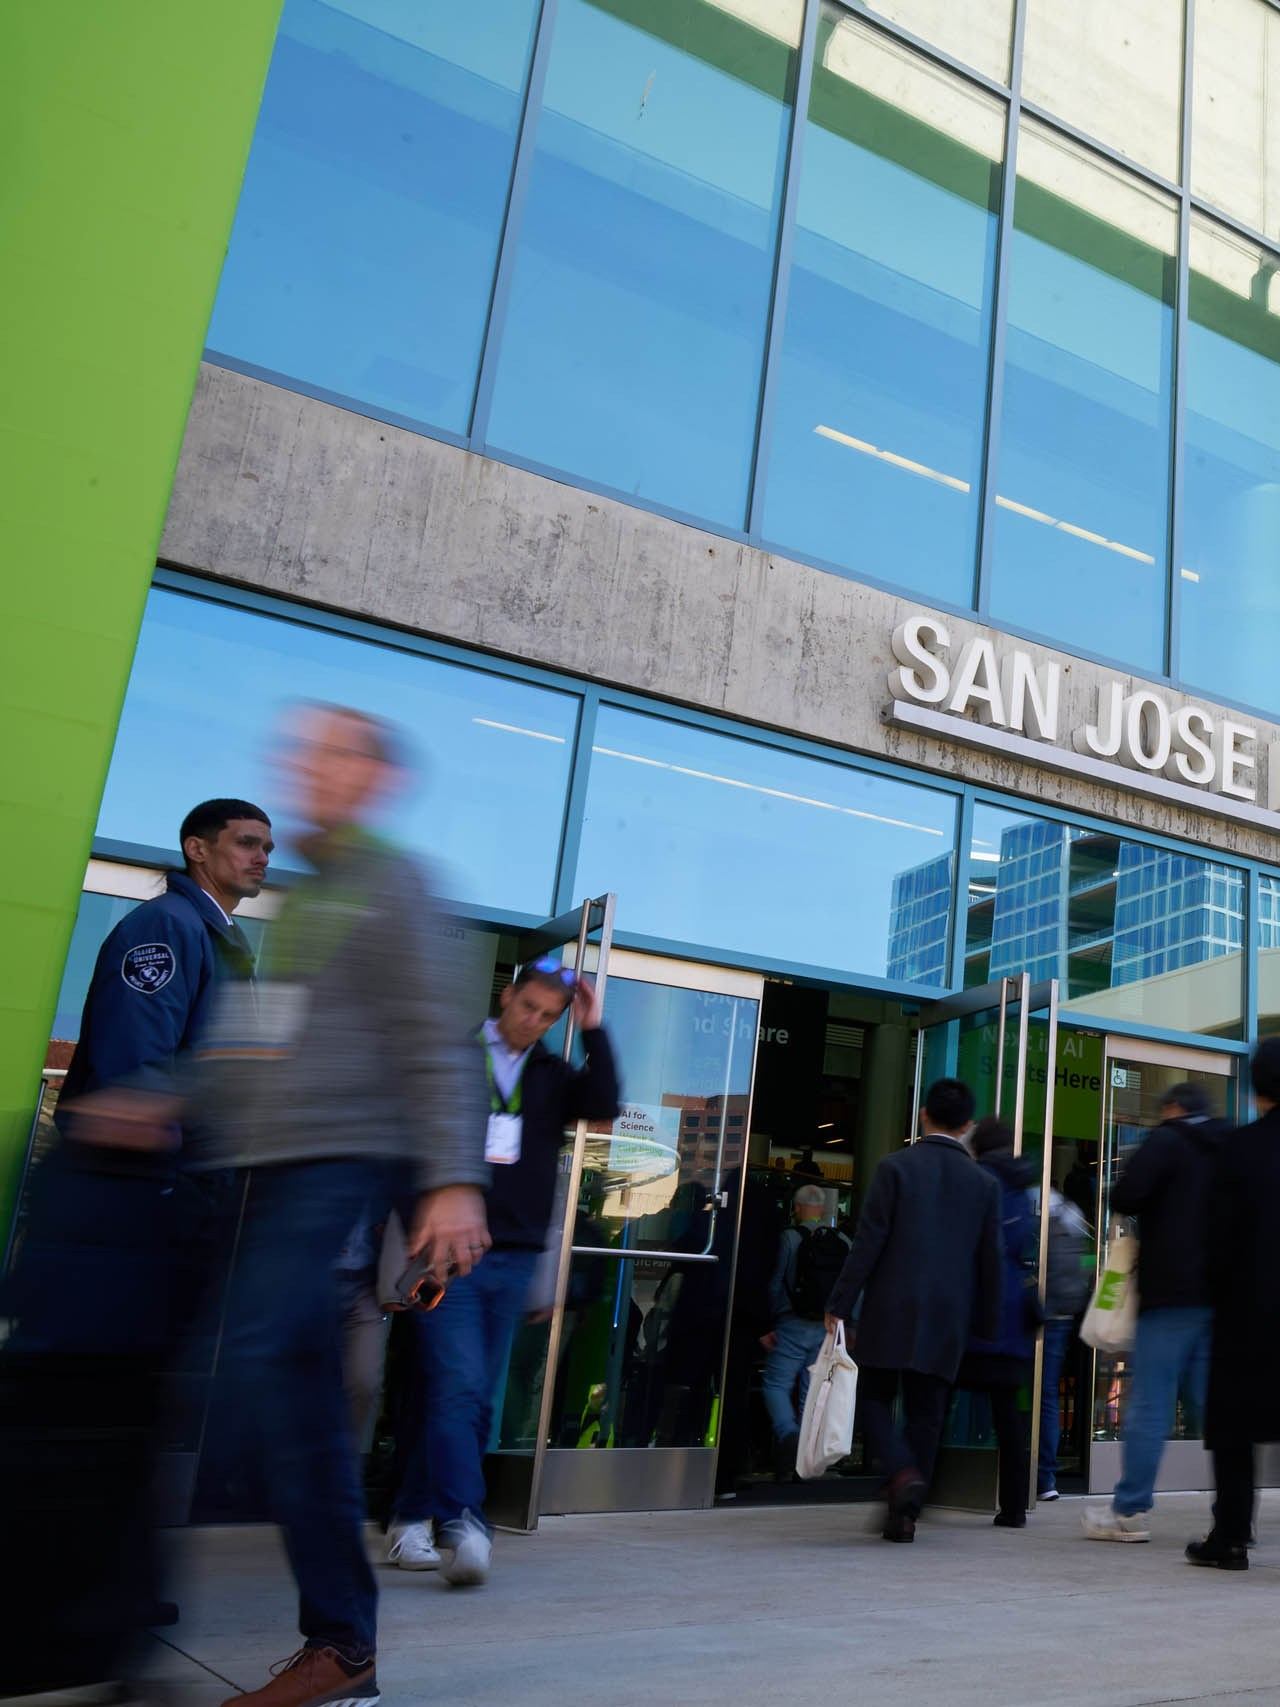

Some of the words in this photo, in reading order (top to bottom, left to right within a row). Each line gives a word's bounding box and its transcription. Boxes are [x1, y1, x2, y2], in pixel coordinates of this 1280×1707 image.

[888, 616, 1060, 742] SAN
[1073, 680, 1257, 801] JOSE
[133, 952, 169, 963] UNIVERSAL
[1054, 1066, 1101, 1091] Here
[633, 1111, 647, 1120] for
[620, 1121, 655, 1132] Science
